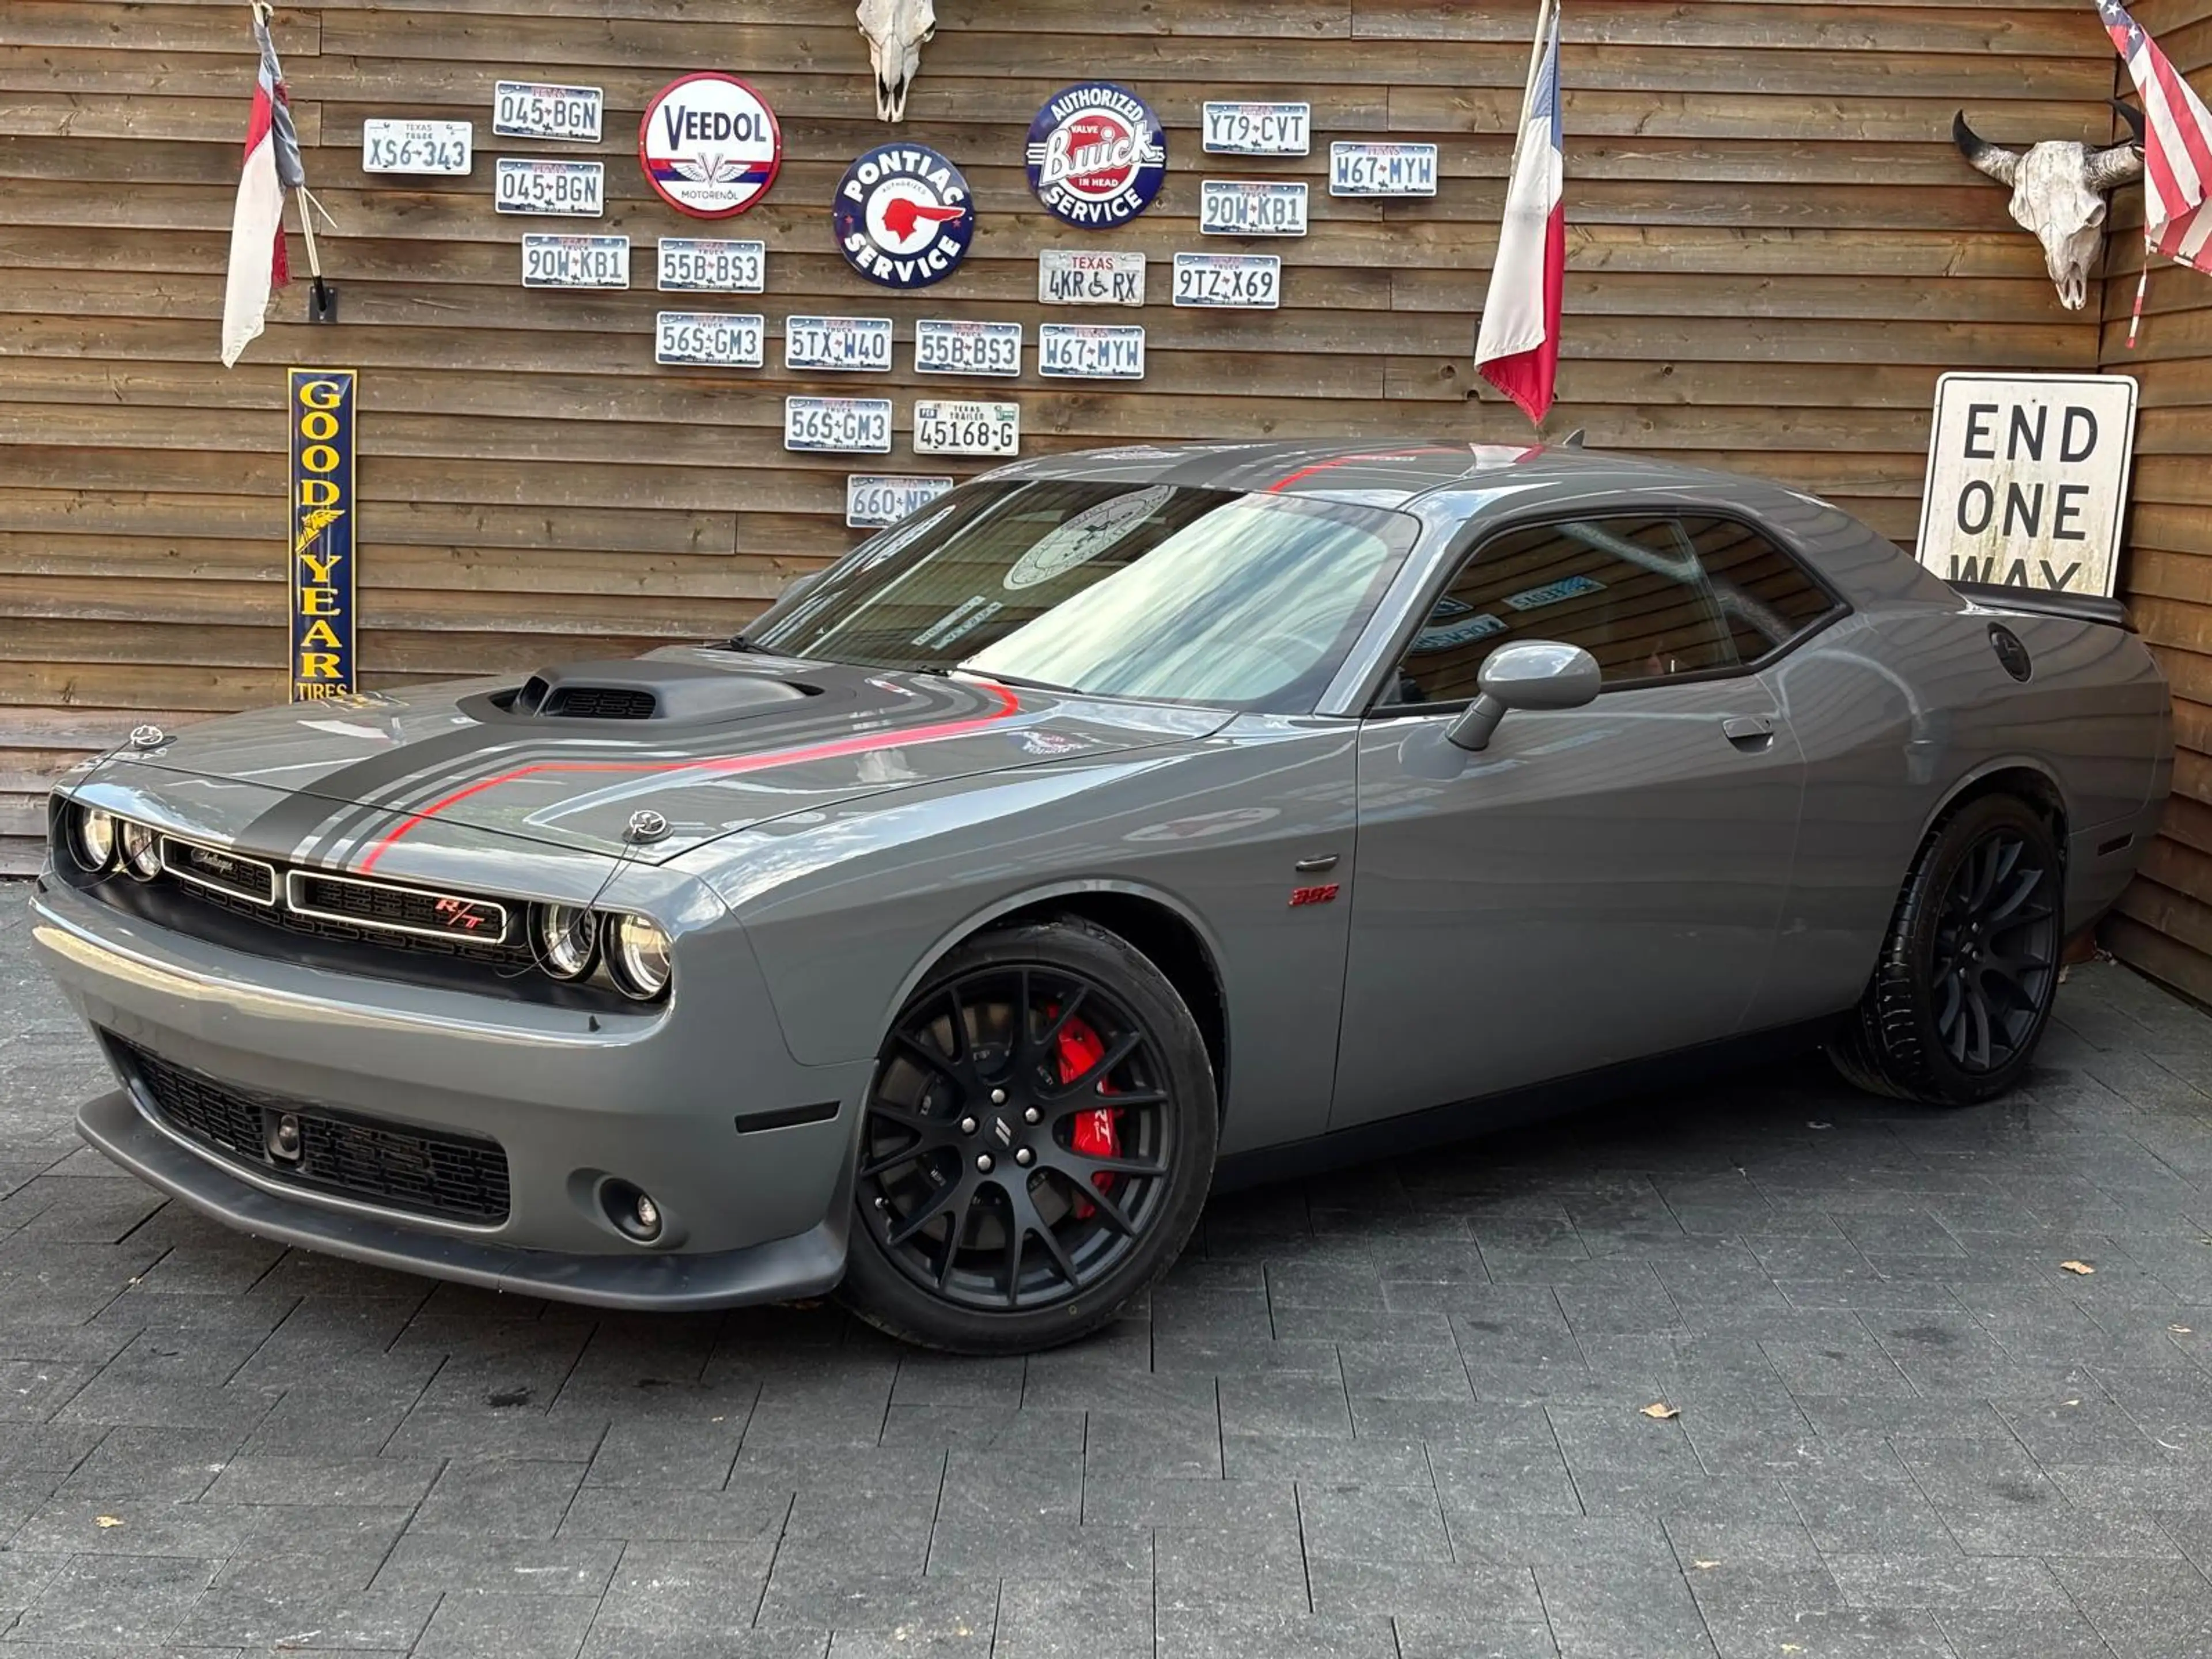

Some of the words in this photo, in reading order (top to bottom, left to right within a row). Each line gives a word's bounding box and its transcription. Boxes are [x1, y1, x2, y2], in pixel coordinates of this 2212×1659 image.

[1051, 88, 1144, 122] AUTHORIZED
[1039, 120, 1154, 187] Buick
[844, 151, 964, 206] PONTIAC
[1092, 179, 1119, 187] HEAD
[1046, 186, 1142, 222] SERVICE
[844, 233, 961, 282] SERVICE
[1072, 257, 1113, 270] TEXAS
[1050, 271, 1084, 298] 4KR
[1113, 273, 1138, 299] RX
[1964, 403, 2098, 463] END
[1957, 479, 2089, 540] ONE
[297, 683, 347, 700] TIRES
[435, 900, 485, 929] R/T
